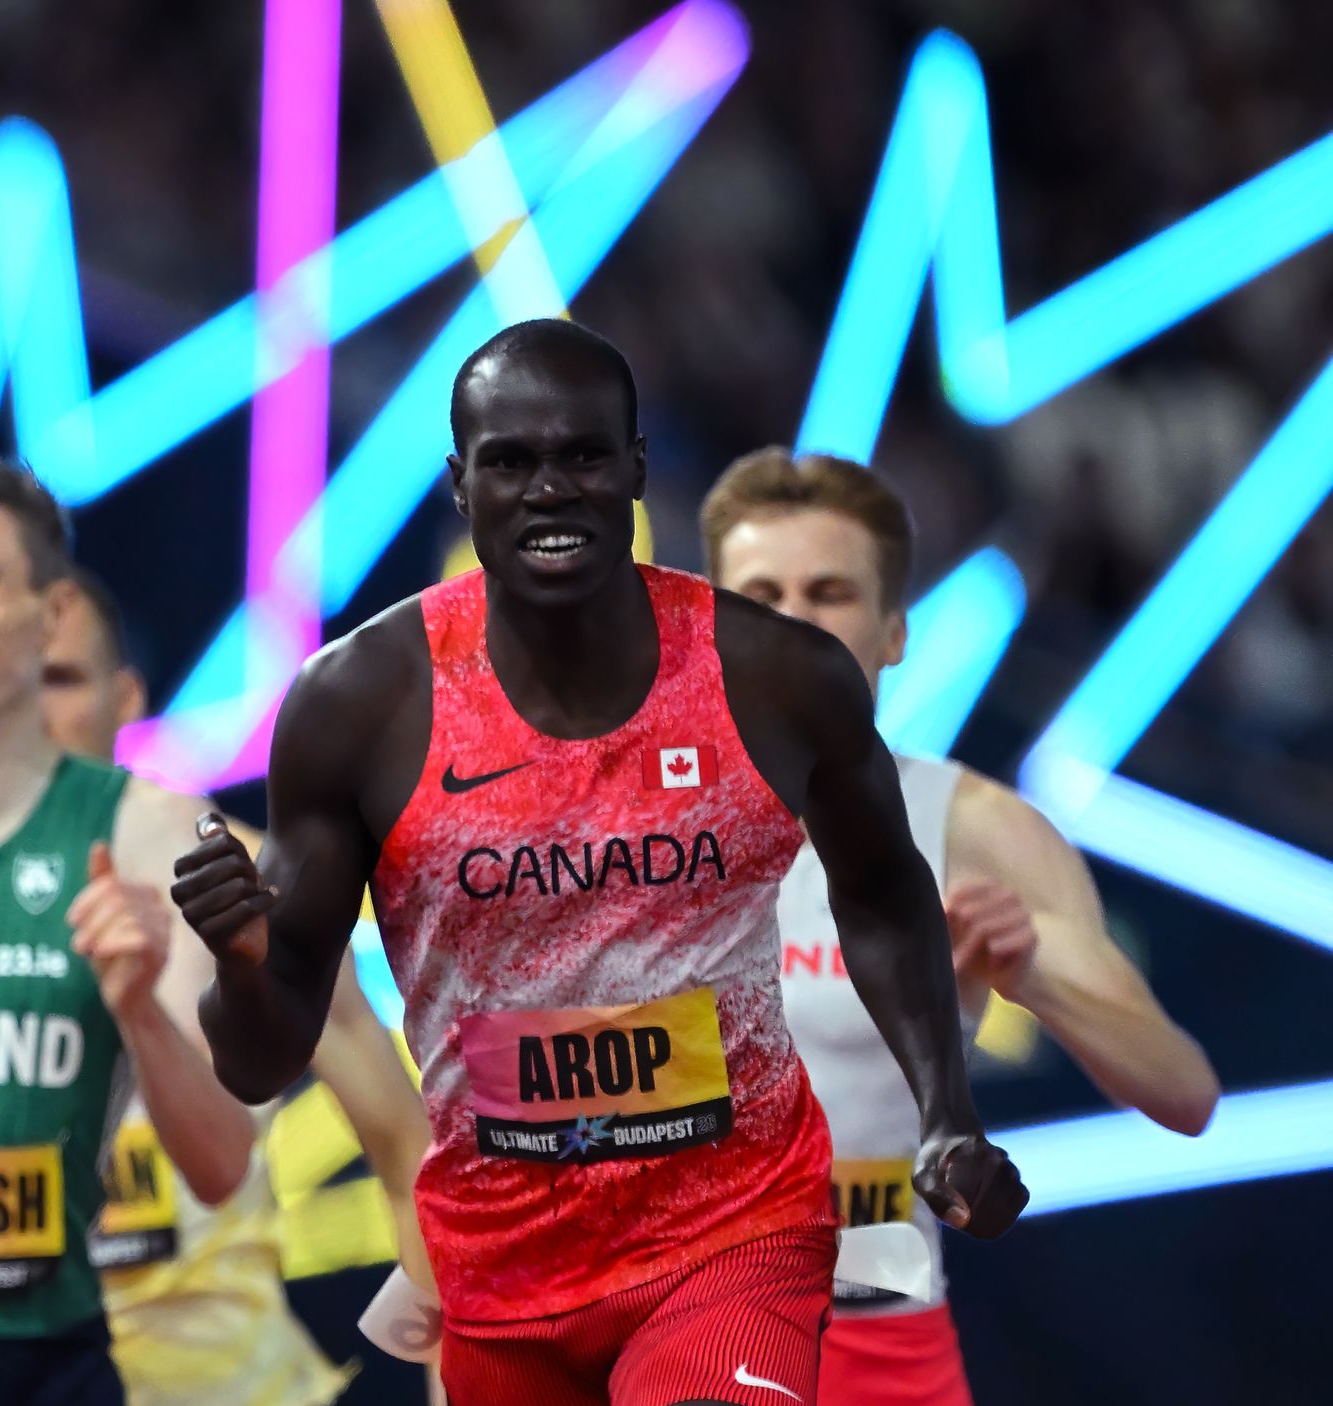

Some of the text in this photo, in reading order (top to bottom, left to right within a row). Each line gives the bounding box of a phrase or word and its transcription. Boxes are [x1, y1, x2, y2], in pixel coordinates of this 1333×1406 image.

[458, 830, 727, 900] CANADA
[517, 1026, 672, 1104] AROP
[489, 1130, 559, 1153] ULTIMATE
[613, 1117, 695, 1147] BUDAPEST
